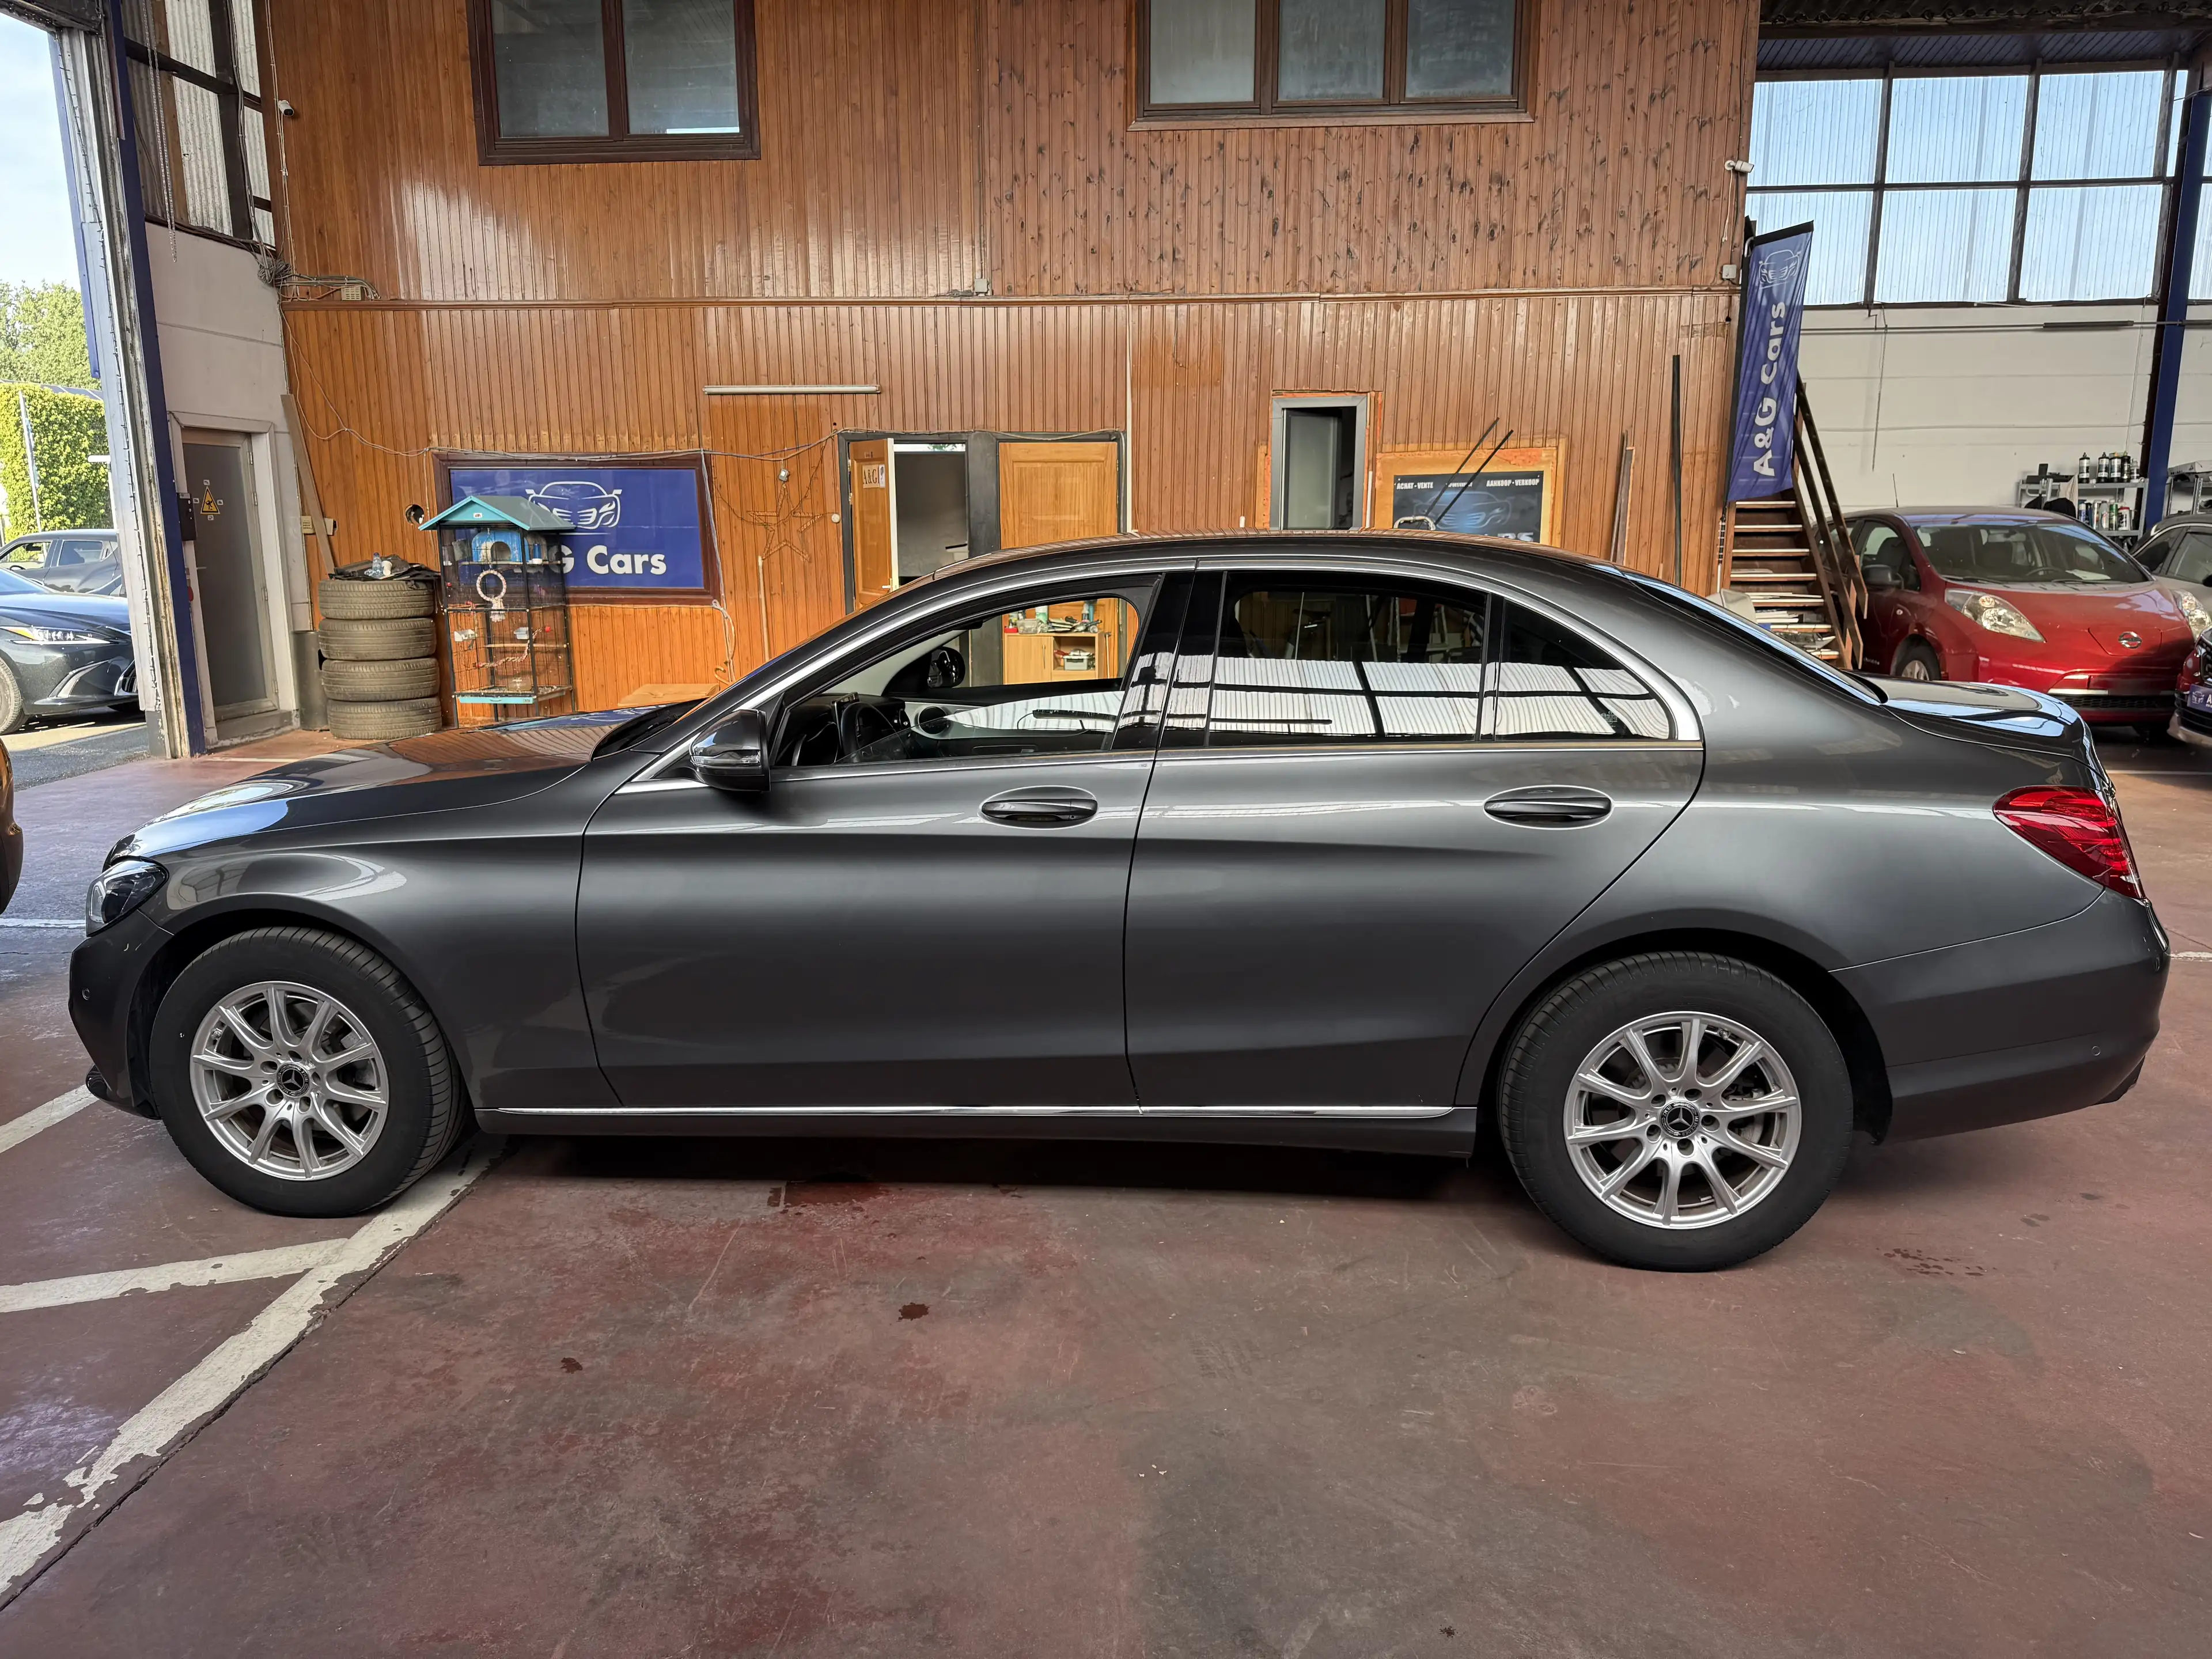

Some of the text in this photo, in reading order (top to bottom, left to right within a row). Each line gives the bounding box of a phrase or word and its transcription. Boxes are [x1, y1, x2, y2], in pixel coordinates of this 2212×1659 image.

[1753, 301, 1785, 477] A&G Cars
[586, 545, 666, 575] Cars
